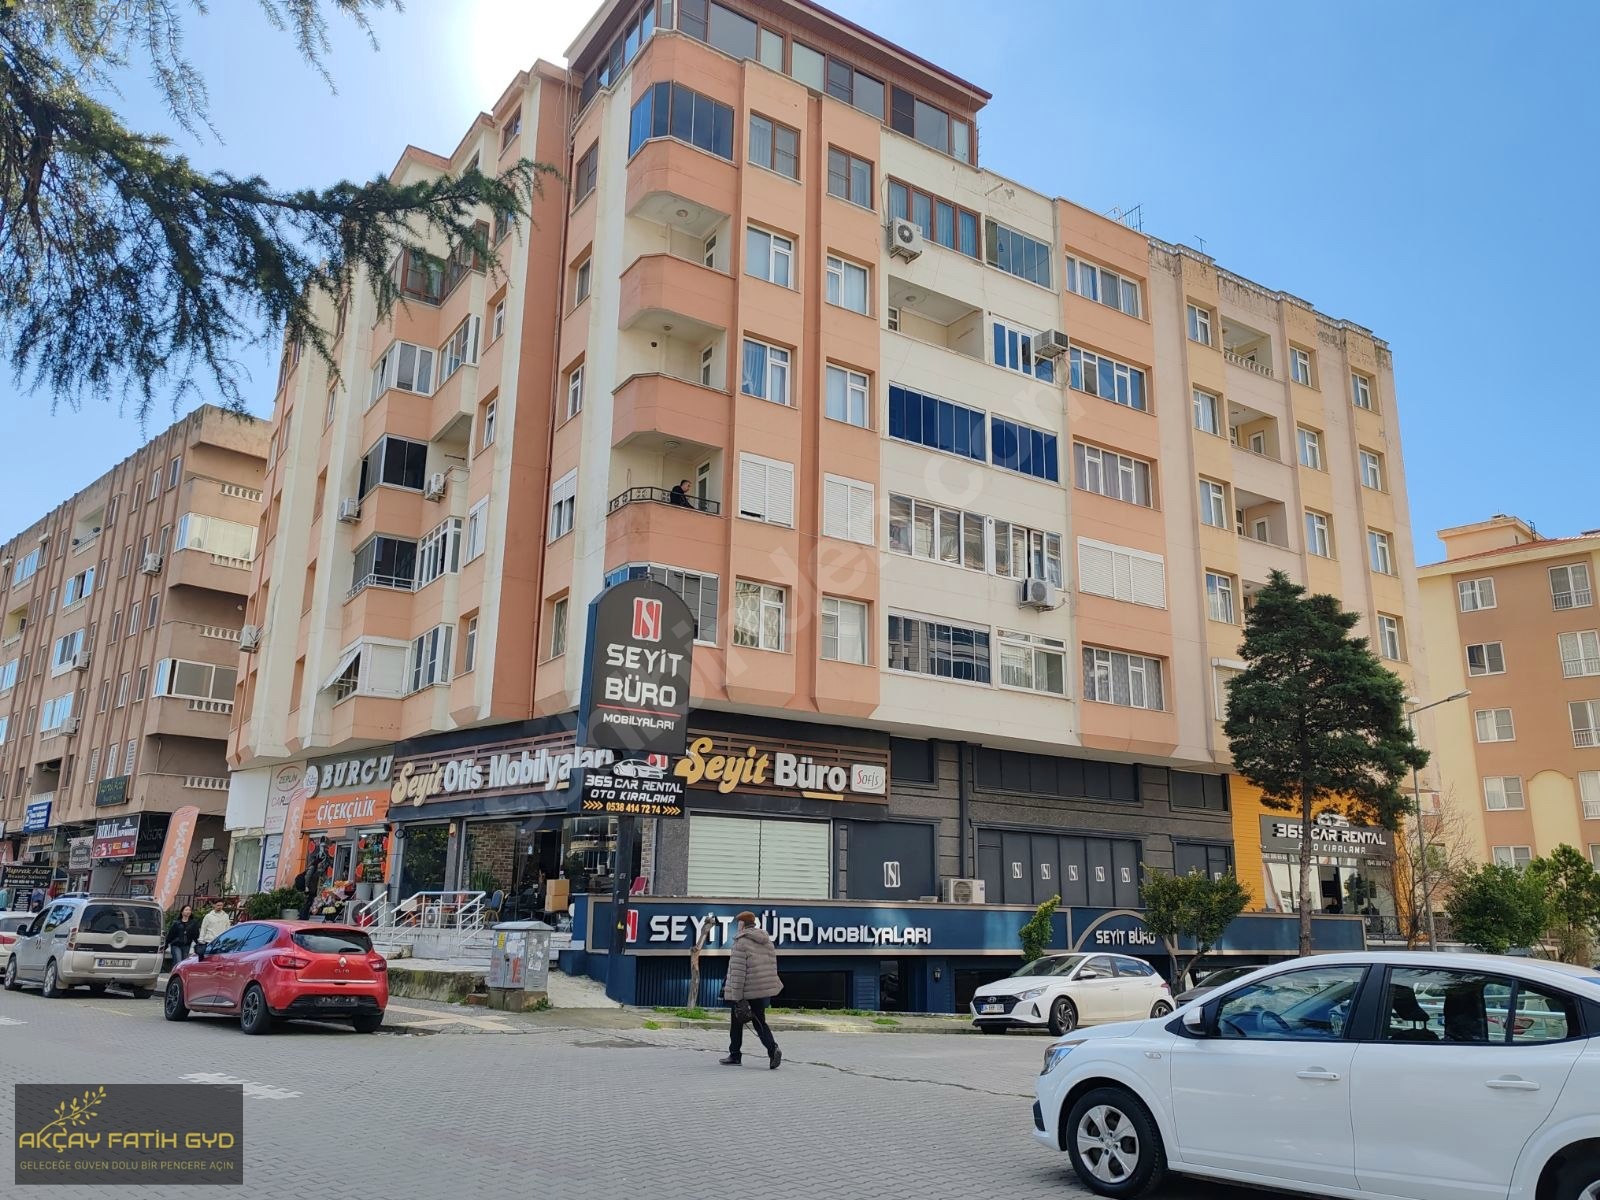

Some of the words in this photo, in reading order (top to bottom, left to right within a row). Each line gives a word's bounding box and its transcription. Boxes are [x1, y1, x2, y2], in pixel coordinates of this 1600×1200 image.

[605, 643, 684, 678] SEYİT
[605, 674, 677, 708] BÜRO
[602, 712, 675, 731] MOBİLYALARI
[320, 755, 393, 789] BURCU
[391, 761, 444, 806] Seyit
[443, 756, 483, 792] Ofis
[673, 737, 769, 794] Seyit
[774, 752, 847, 792] Büro
[584, 774, 613, 788] 365
[614, 778, 639, 790] CAR
[641, 780, 684, 794] RENTAL
[590, 788, 616, 800] OTO
[317, 795, 376, 826] ÇİÇEKÇİLİK
[606, 801, 625, 812] 0538
[625, 803, 640, 813] 414
[641, 804, 650, 813] 72
[651, 804, 661, 814] 74
[1310, 827, 1338, 842] CAR
[1341, 829, 1387, 846] RENTAL
[649, 912, 734, 944] SEYİT
[752, 910, 813, 945] ÜRO
[817, 924, 931, 945] MOBİLYALARI
[1096, 928, 1126, 946] SEYİT
[1128, 927, 1156, 946] BÜRO
